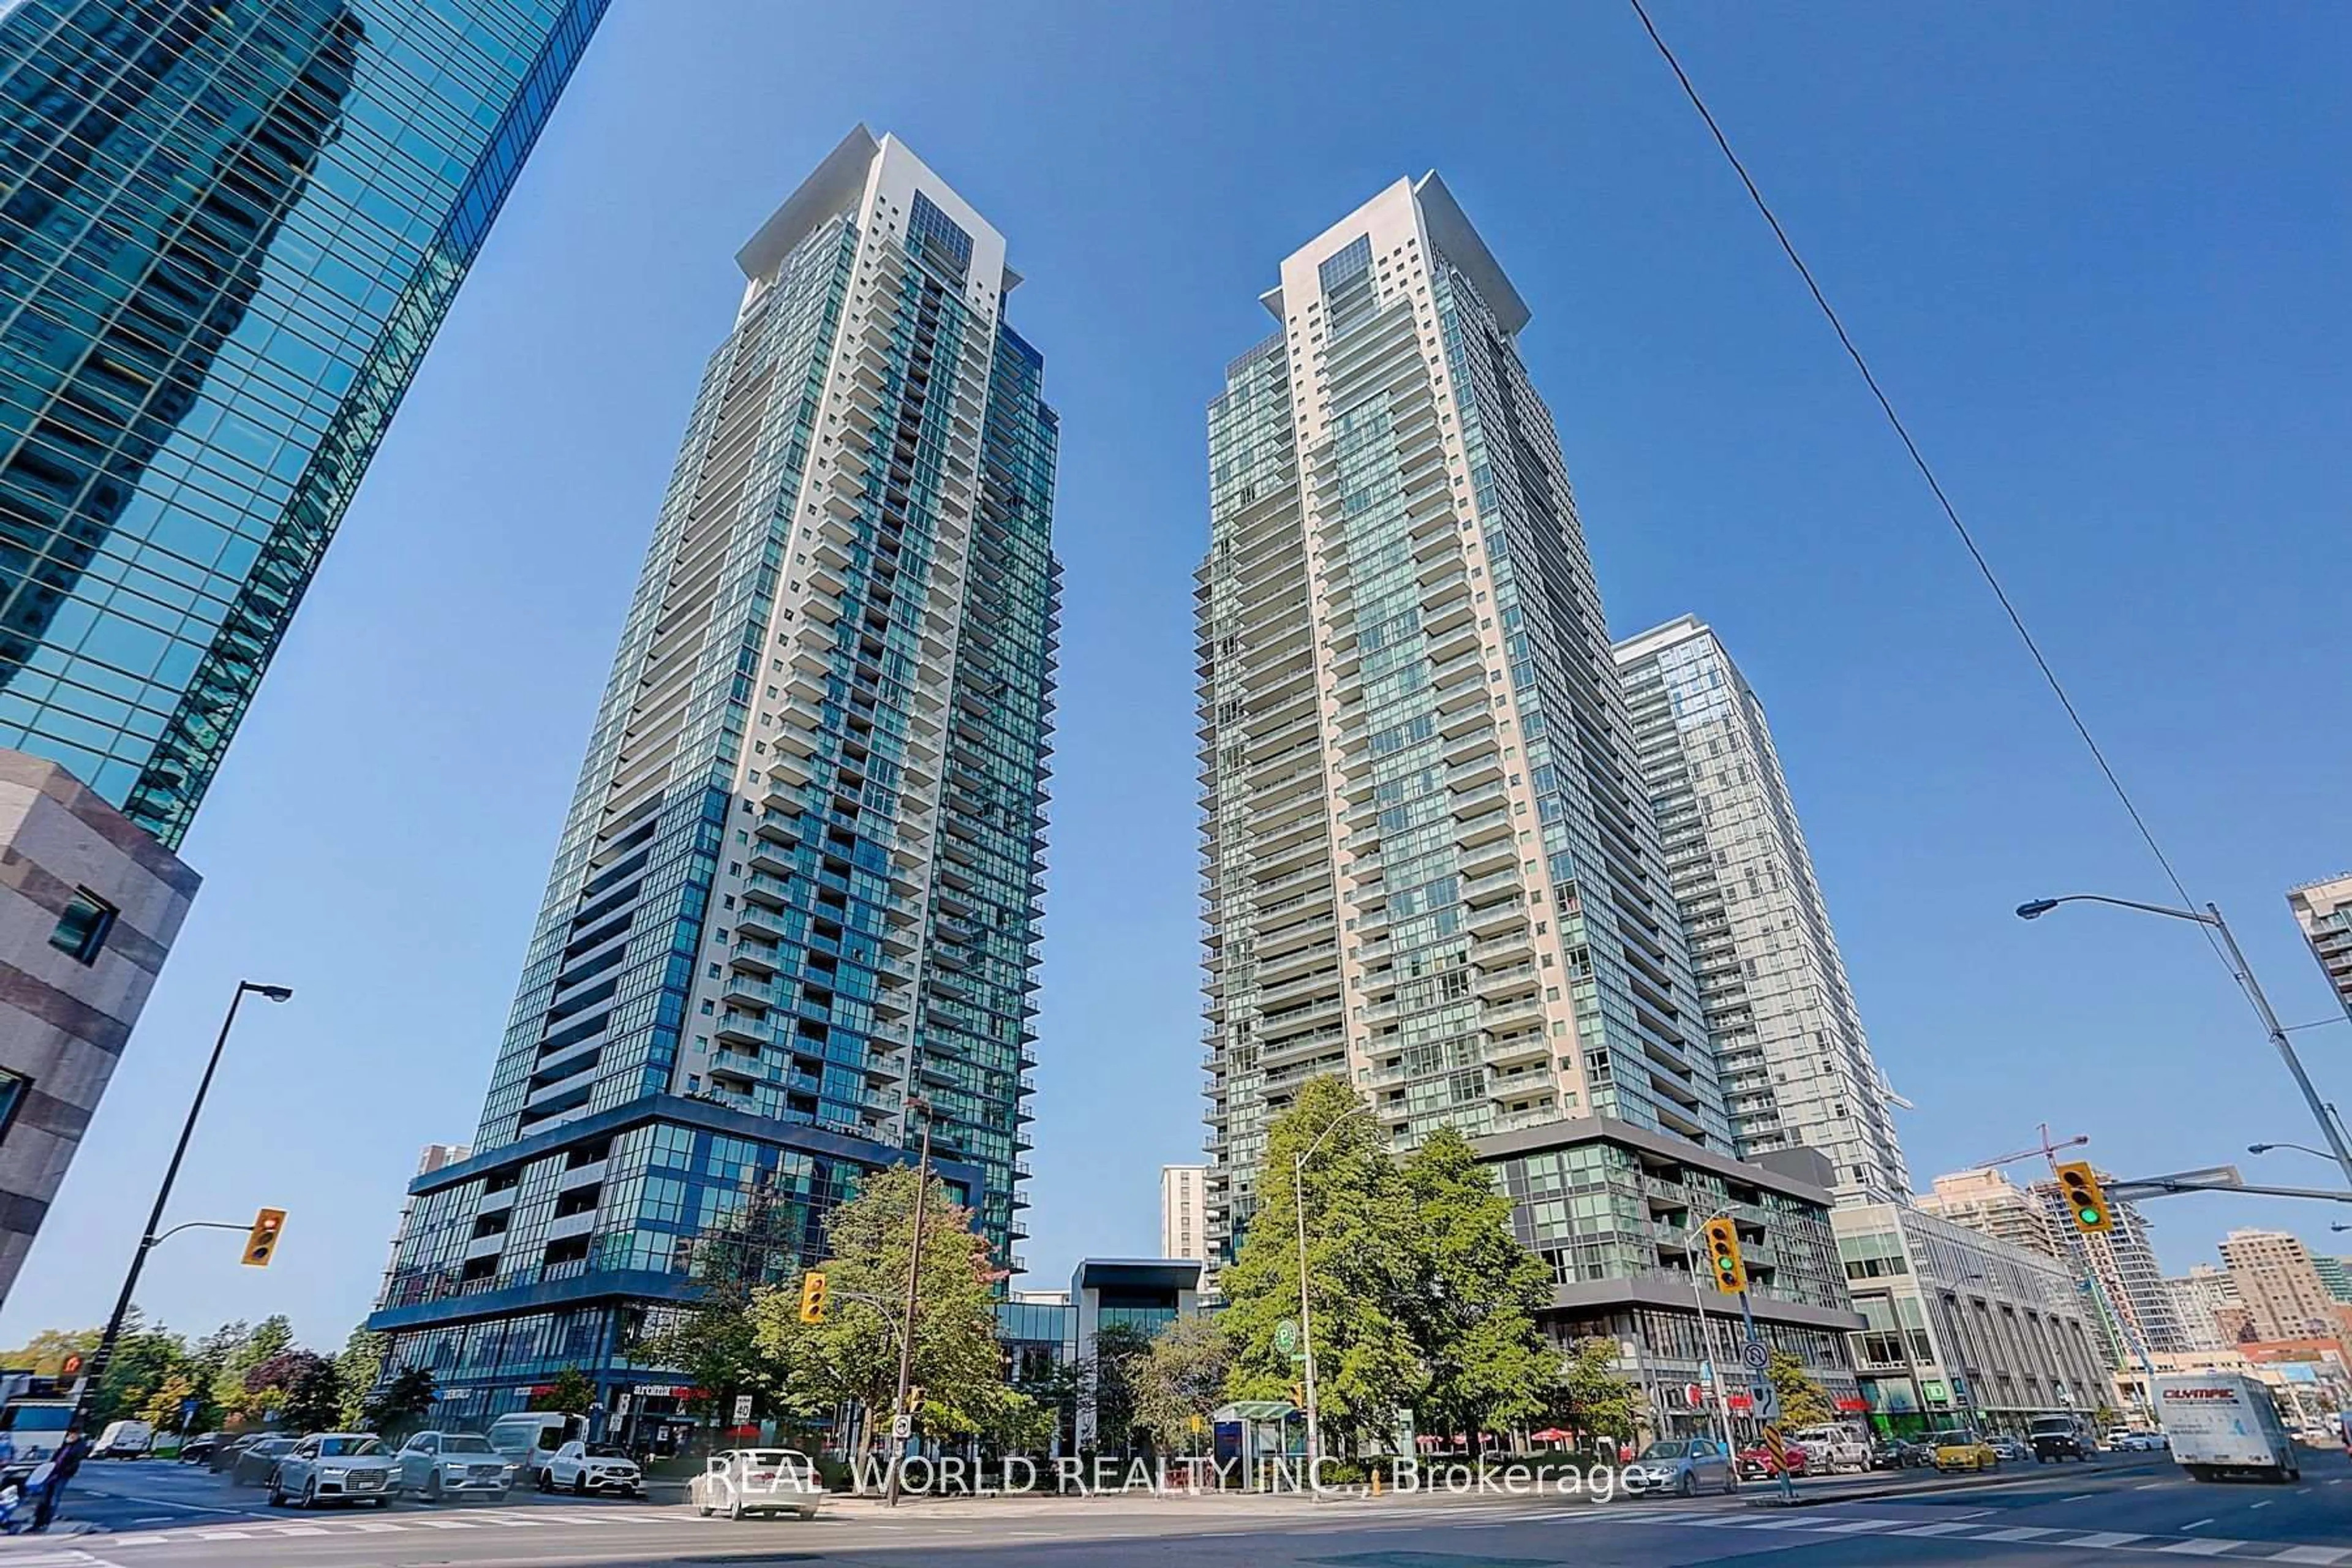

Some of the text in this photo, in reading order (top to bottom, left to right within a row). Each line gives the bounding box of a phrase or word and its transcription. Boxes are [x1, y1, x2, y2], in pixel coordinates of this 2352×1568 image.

[1926, 1385, 1944, 1396] TD
[2163, 1389, 2234, 1398] OLYMPIC
[737, 1406, 748, 1419] 40
